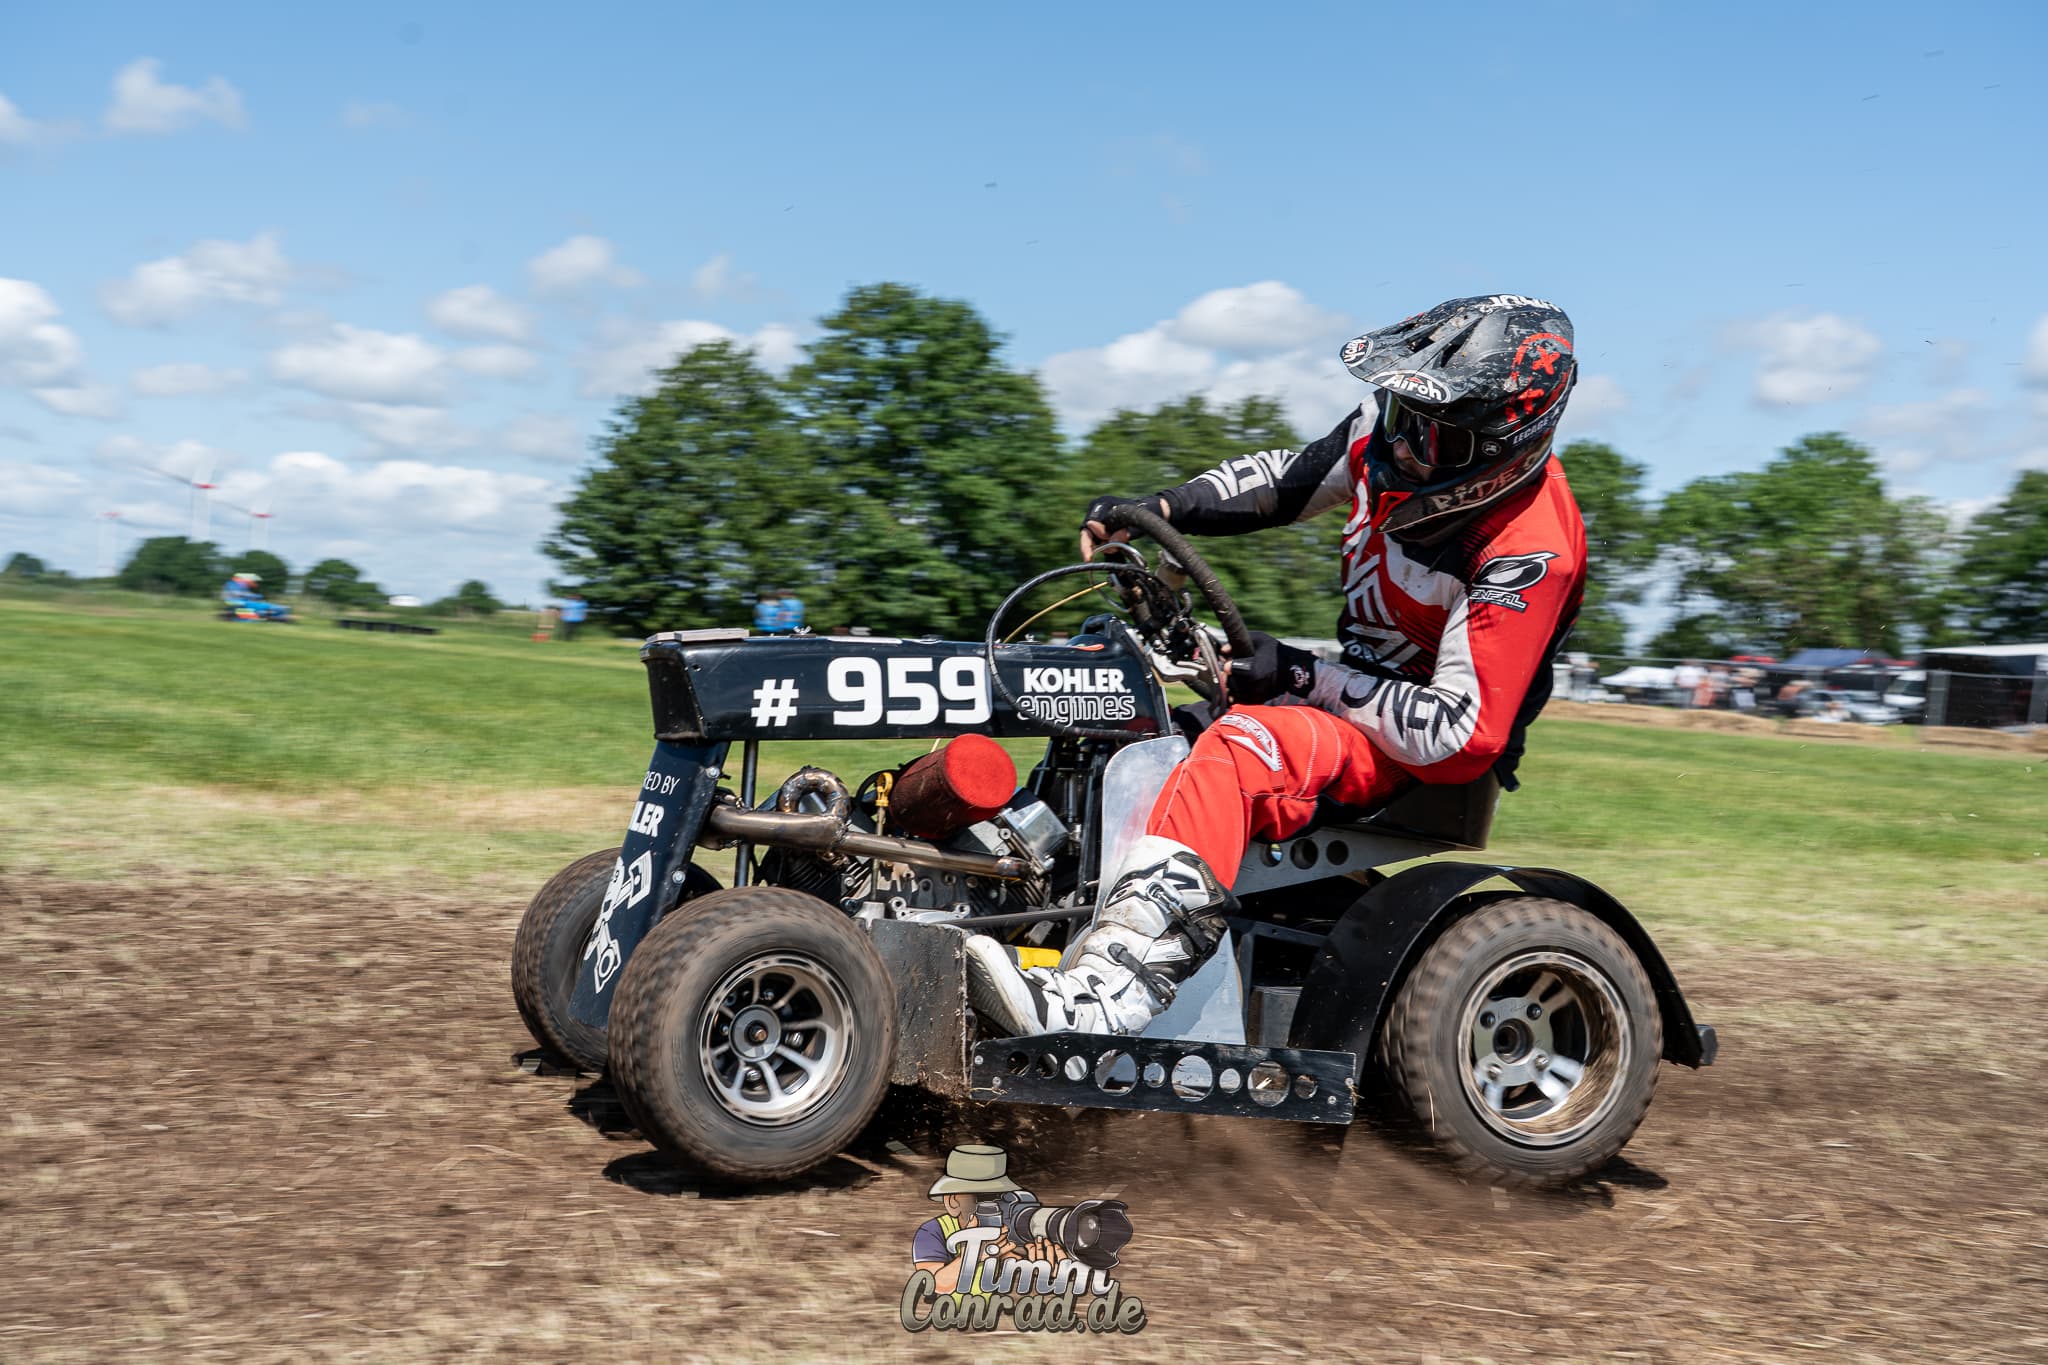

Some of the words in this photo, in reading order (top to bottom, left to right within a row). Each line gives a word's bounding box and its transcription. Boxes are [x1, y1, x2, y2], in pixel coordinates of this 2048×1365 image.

[1382, 373, 1443, 401] Airoh
[751, 678, 800, 728] #
[826, 656, 993, 726] 959
[1016, 695, 1137, 728] engines
[660, 774, 681, 796] BY
